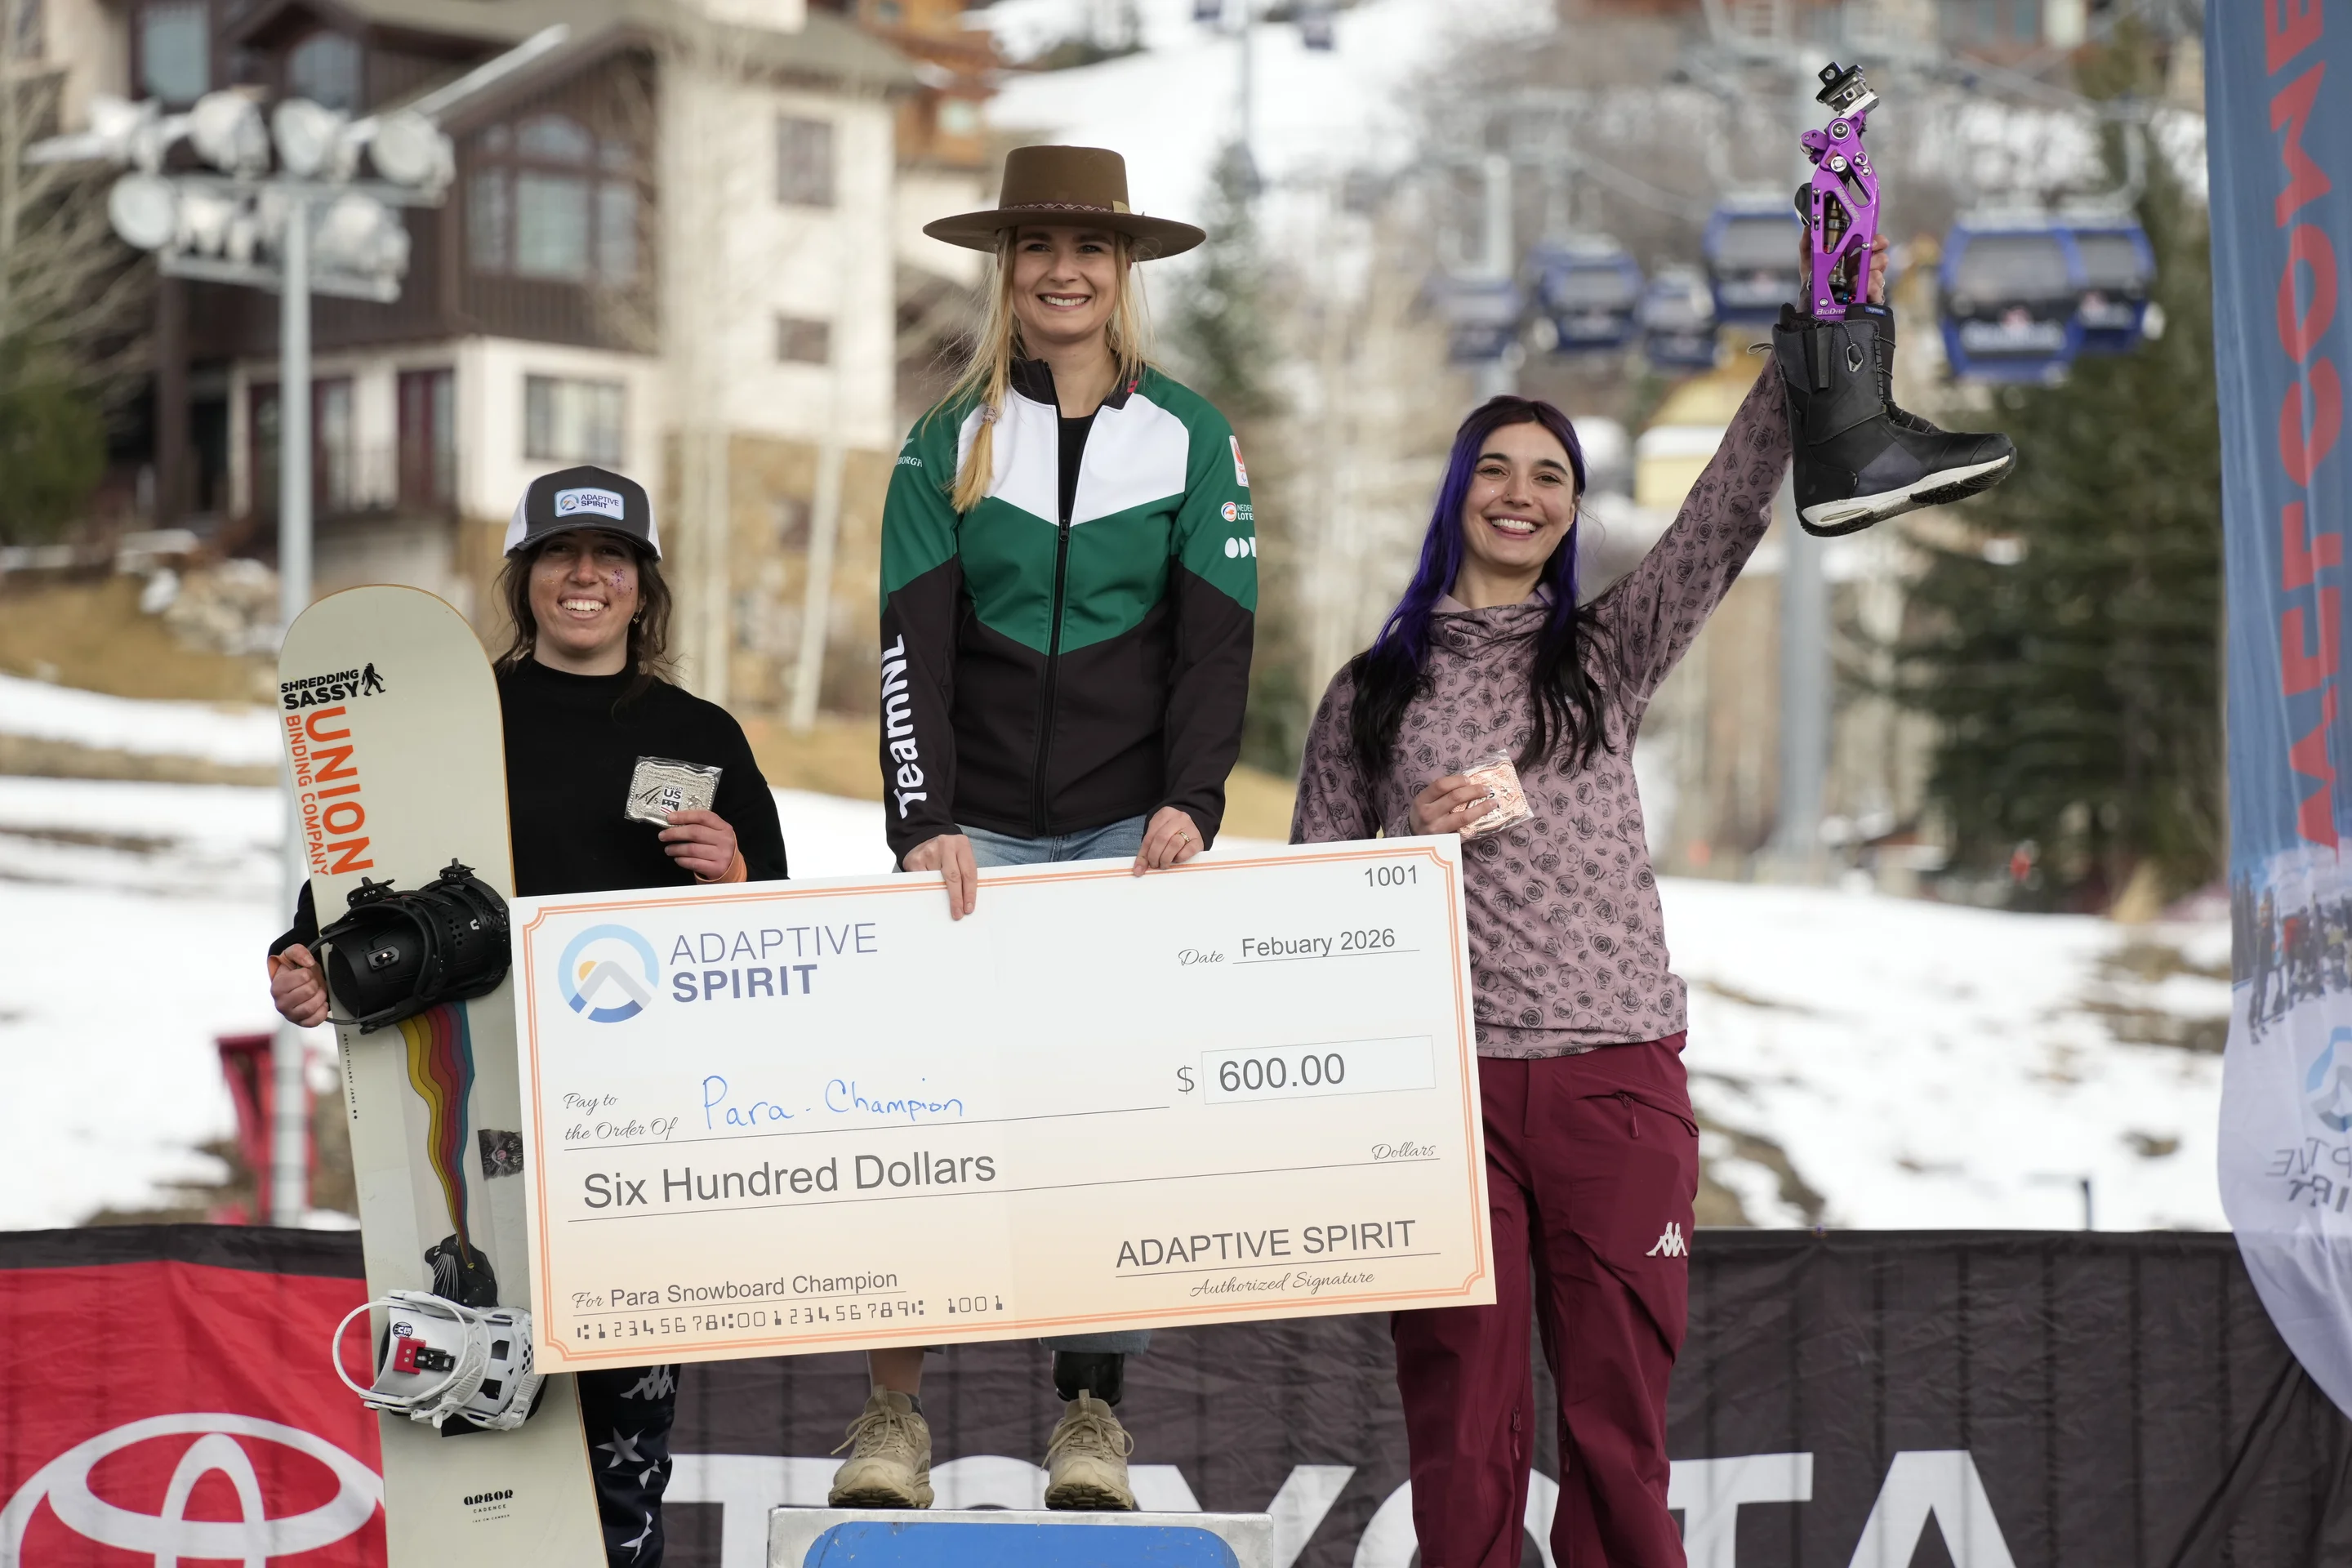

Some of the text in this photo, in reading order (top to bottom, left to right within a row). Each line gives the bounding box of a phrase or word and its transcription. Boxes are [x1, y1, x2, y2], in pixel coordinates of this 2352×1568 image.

[581, 494, 619, 506] ADAPTIVE
[581, 500, 608, 508] SPIRIT
[281, 669, 359, 693] SHREDDING
[283, 680, 361, 710] SASSY
[881, 634, 927, 819] TeamNL
[285, 715, 329, 876] BINDING COMPANY
[305, 706, 373, 876] UNION
[664, 789, 683, 800] US
[1364, 865, 1418, 887] 1001
[670, 922, 878, 965] ADAPTIVE
[1178, 929, 1396, 966] Date Febuary 2026
[672, 964, 817, 1002] SPIRIT
[1176, 1053, 1346, 1095] $ 600.00
[564, 1092, 619, 1116] Pay to
[702, 1076, 795, 1129] Para
[824, 1076, 964, 1123] Champion
[564, 1116, 679, 1141] the Order Of
[1371, 1142, 1436, 1161] Dollars
[583, 1152, 996, 1209] Six Hundred Dollars
[1116, 1220, 1416, 1268] ADAPTIVE SPIRIT
[572, 1271, 898, 1308] For Para Snowboard Champion
[1190, 1271, 1375, 1298] Authorized Signature
[948, 1295, 1003, 1313] 1001
[464, 1489, 513, 1505] ARBOR
[473, 1504, 506, 1513] CADENCE
